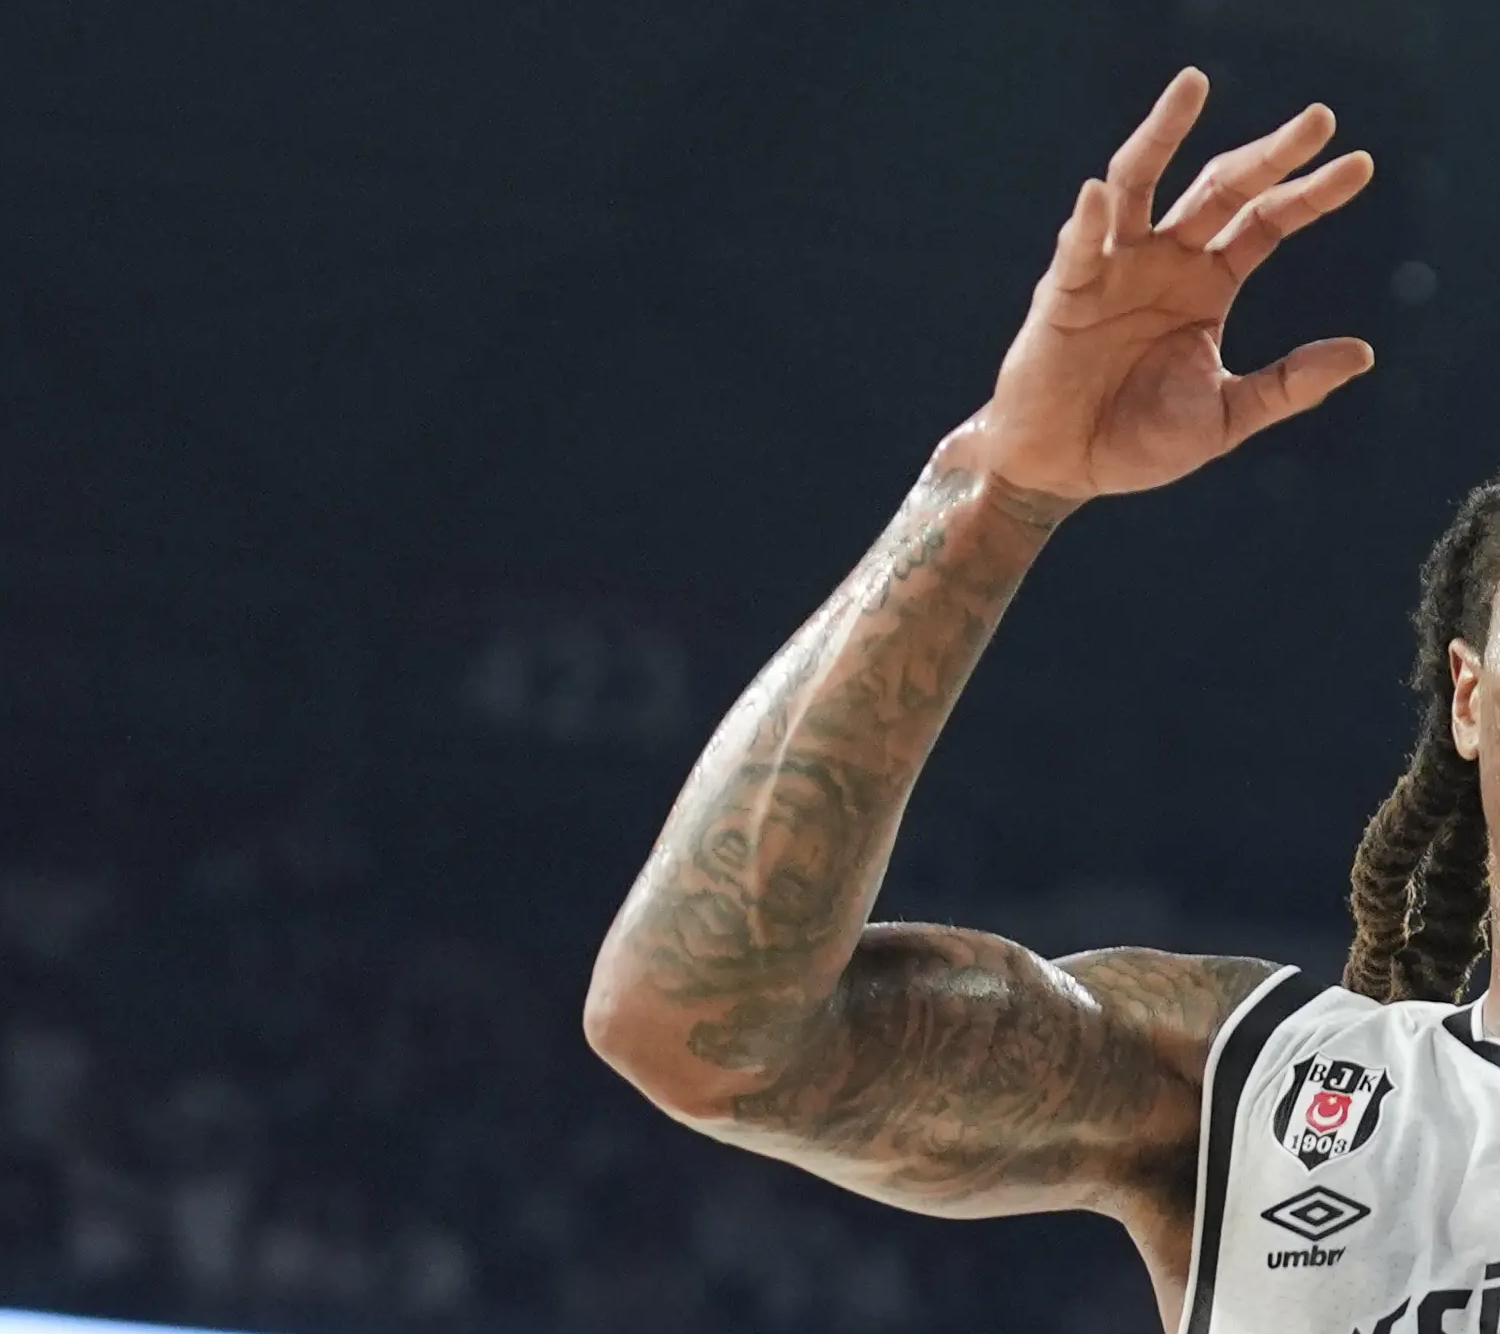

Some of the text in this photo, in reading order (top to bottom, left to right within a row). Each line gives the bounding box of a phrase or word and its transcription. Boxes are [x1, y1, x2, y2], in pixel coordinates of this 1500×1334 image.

[1308, 1063, 1379, 1094] BJK
[1289, 1133, 1348, 1155] 1903
[1267, 1245, 1346, 1269] umbr
